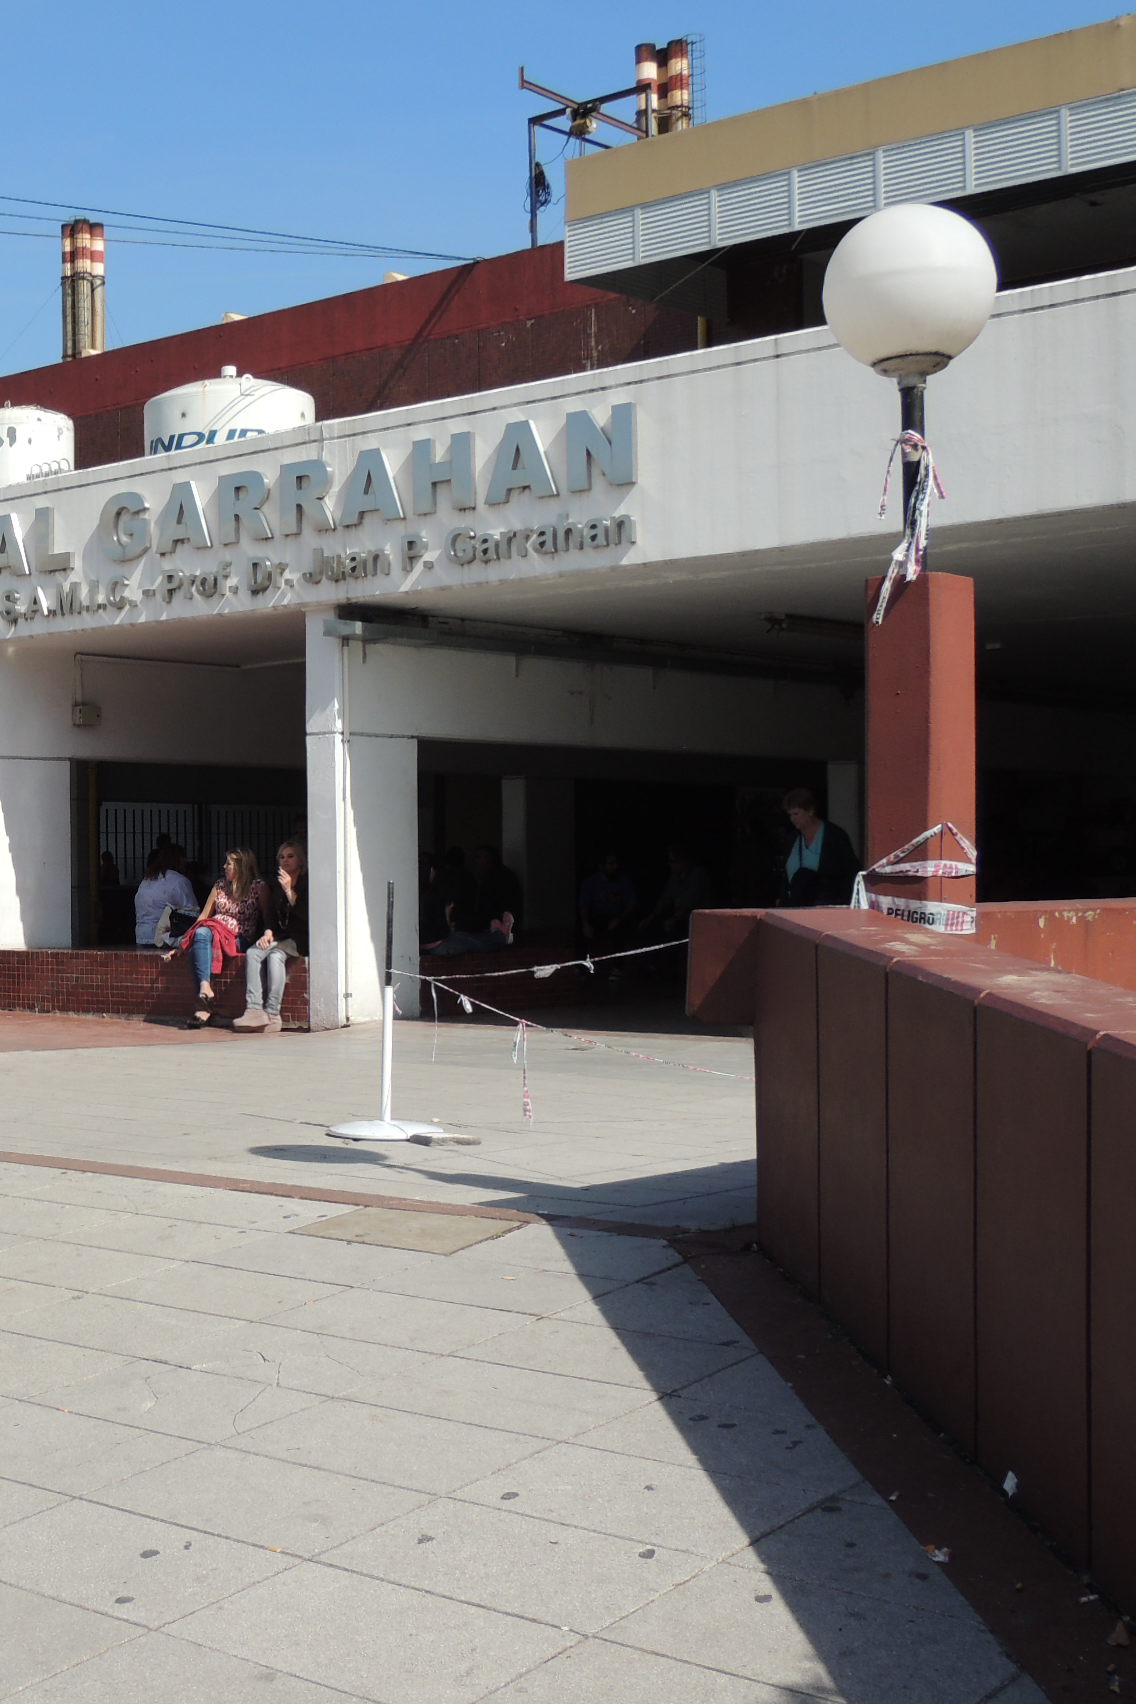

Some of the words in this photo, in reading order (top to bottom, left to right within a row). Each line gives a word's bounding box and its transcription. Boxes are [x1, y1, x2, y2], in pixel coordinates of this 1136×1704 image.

[100, 403, 636, 561] GARRAHAN
[161, 560, 238, 604] Prof.
[248, 556, 294, 594] Dr.
[302, 547, 391, 585] Juan
[400, 534, 434, 573] P.
[445, 513, 636, 566] Garrahan
